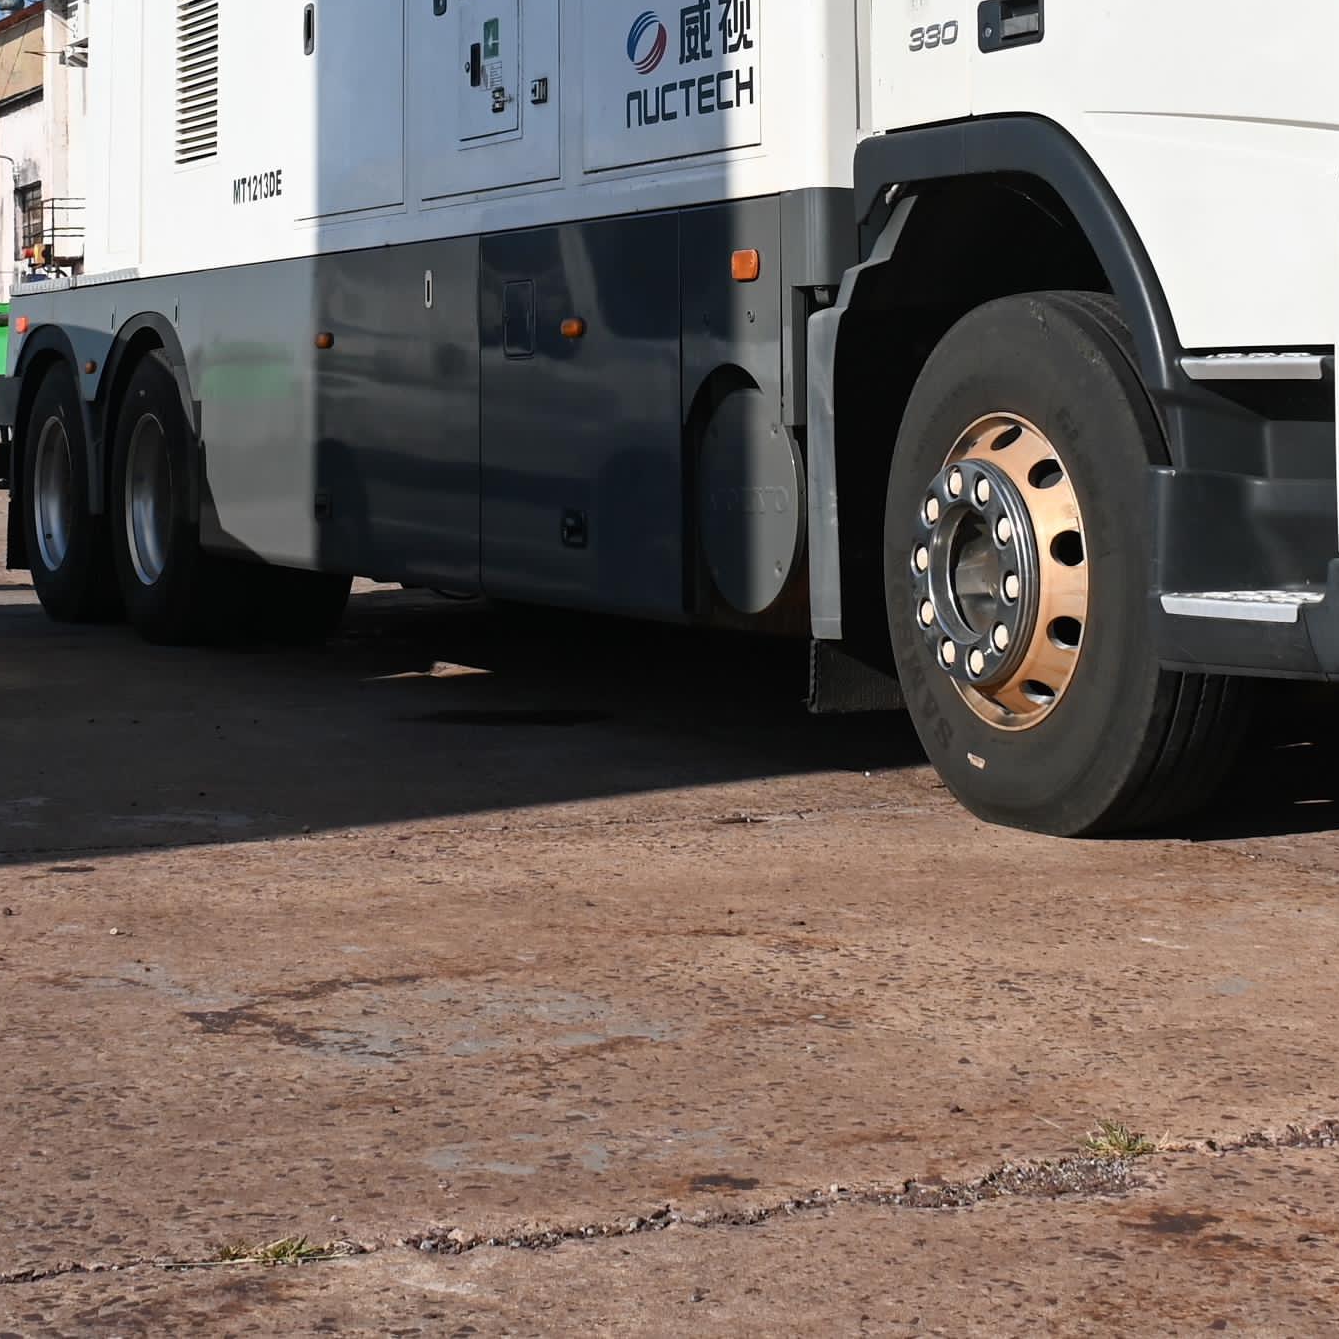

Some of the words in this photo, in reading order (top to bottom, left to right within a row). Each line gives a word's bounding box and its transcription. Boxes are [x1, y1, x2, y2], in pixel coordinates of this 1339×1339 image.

[908, 20, 959, 52] 330
[627, 65, 755, 129] NUCTECH
[233, 168, 283, 206] MT1213DE
